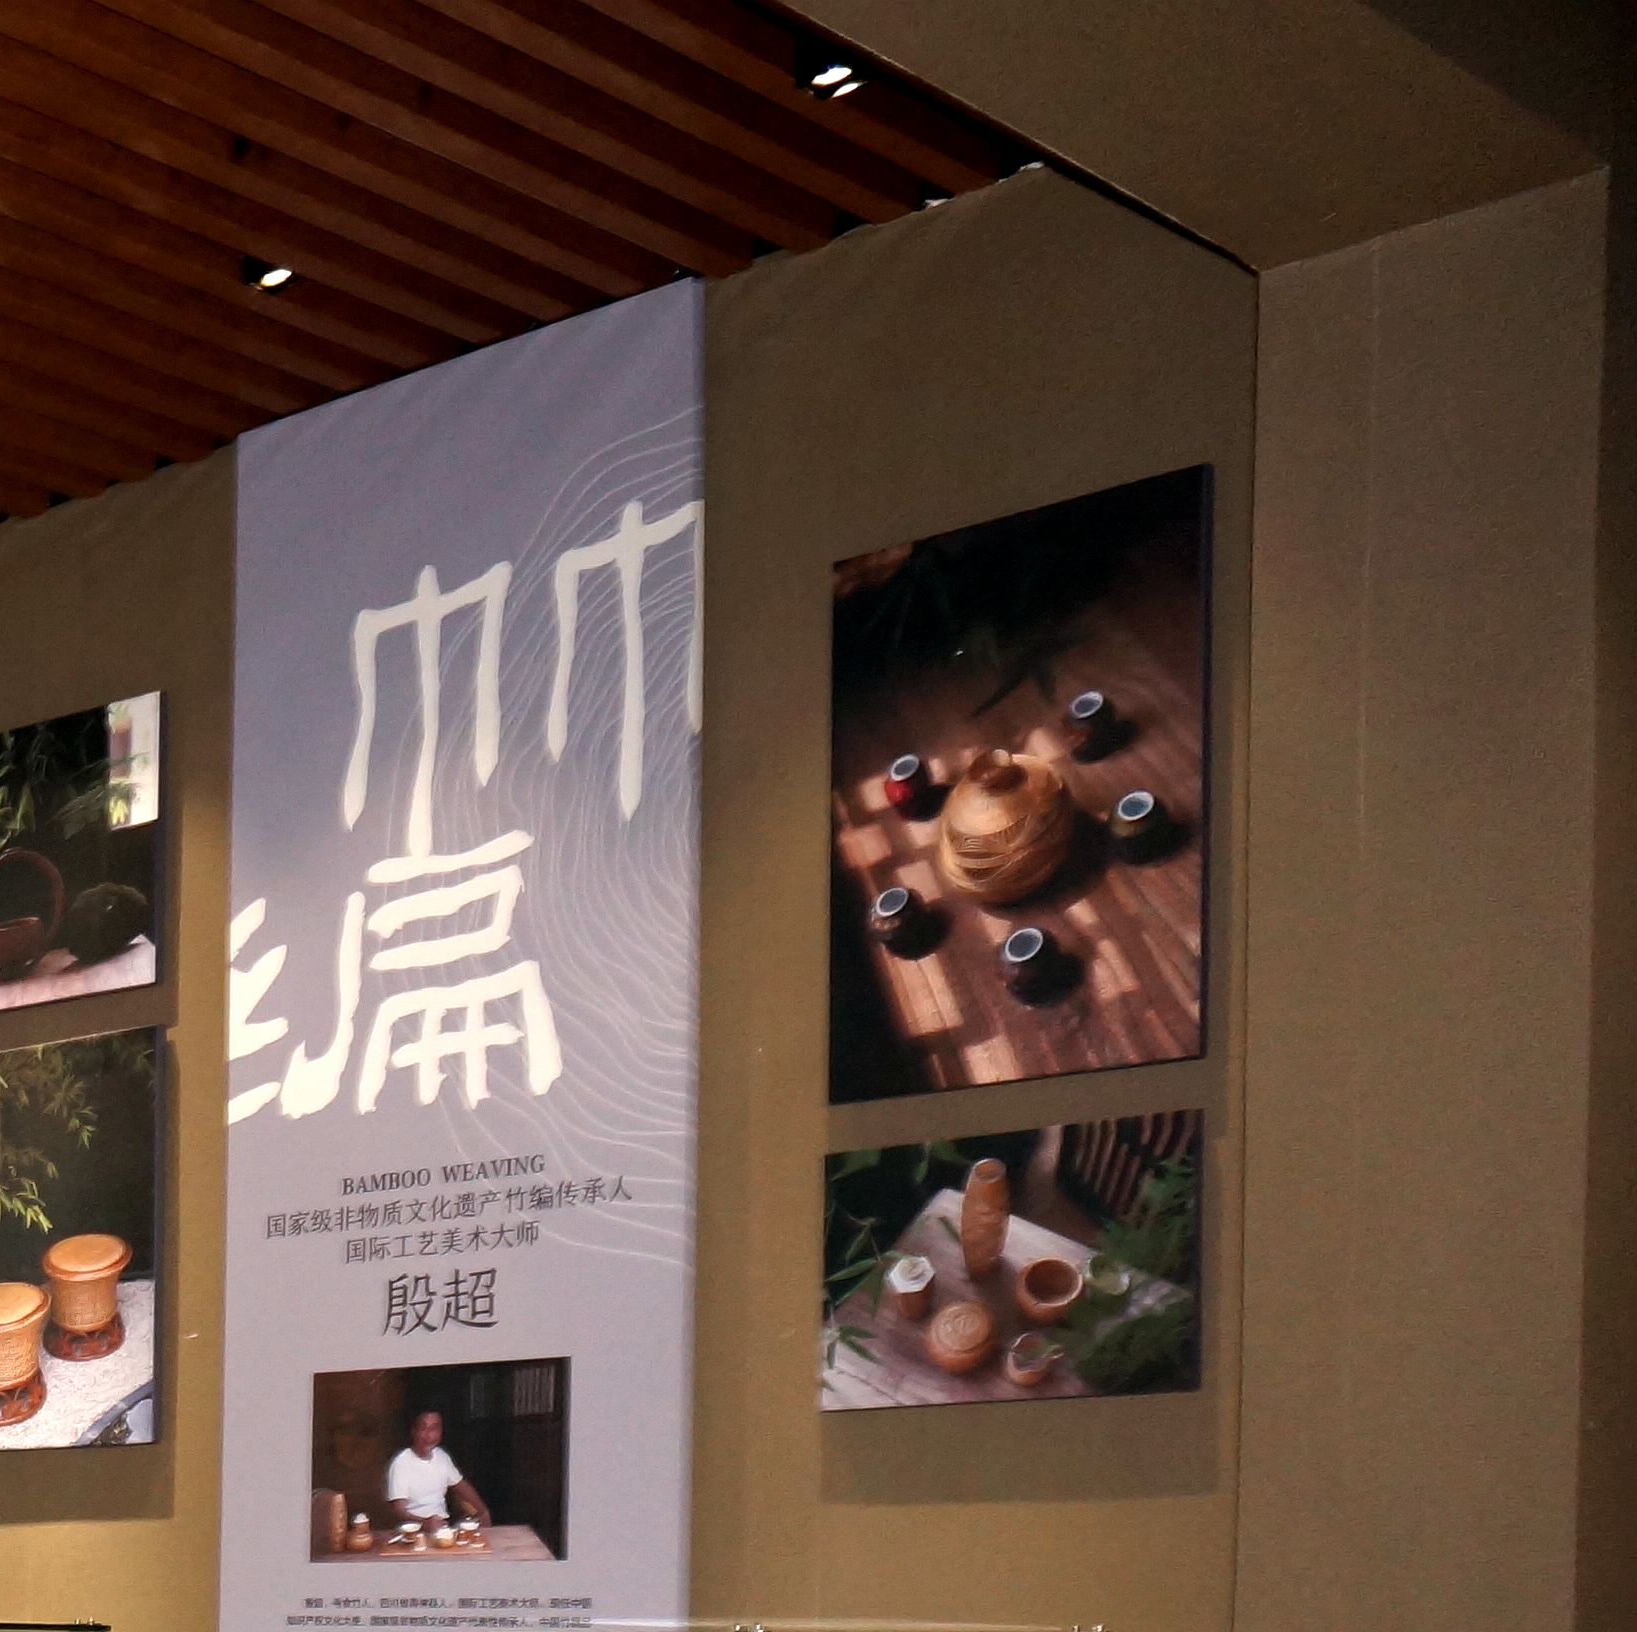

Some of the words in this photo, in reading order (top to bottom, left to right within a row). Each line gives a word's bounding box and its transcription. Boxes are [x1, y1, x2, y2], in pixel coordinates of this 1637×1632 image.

[341, 1167, 432, 1195] BAMBOO
[442, 1153, 546, 1185] WEAVING
[266, 1175, 633, 1239] 国家级非物质文化遗产竹编传承人
[345, 1220, 540, 1265] 国际工艺美术大师
[381, 1267, 500, 1337] 殷超
